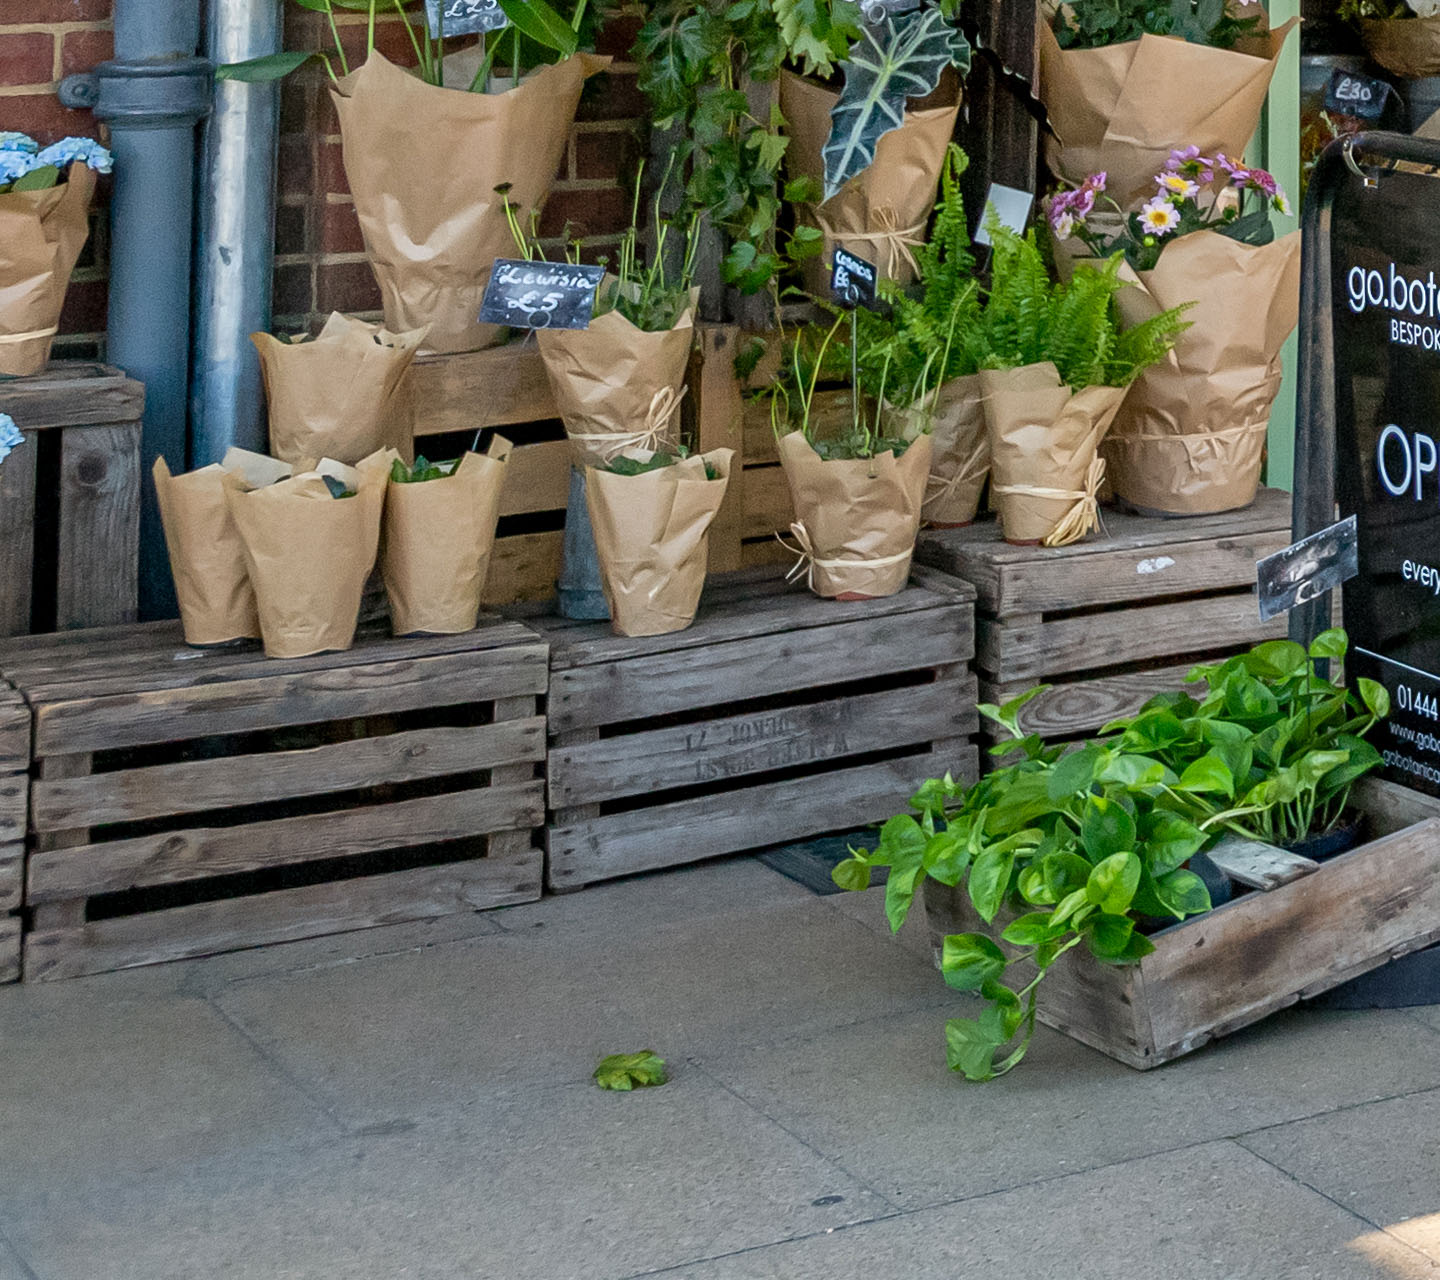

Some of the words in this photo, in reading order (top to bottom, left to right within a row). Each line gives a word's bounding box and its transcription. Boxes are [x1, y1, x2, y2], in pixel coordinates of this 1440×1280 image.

[1336, 77, 1372, 100] £30
[499, 267, 597, 289] Lewisia
[505, 290, 565, 313] £5
[1397, 684, 1438, 721] 01444
